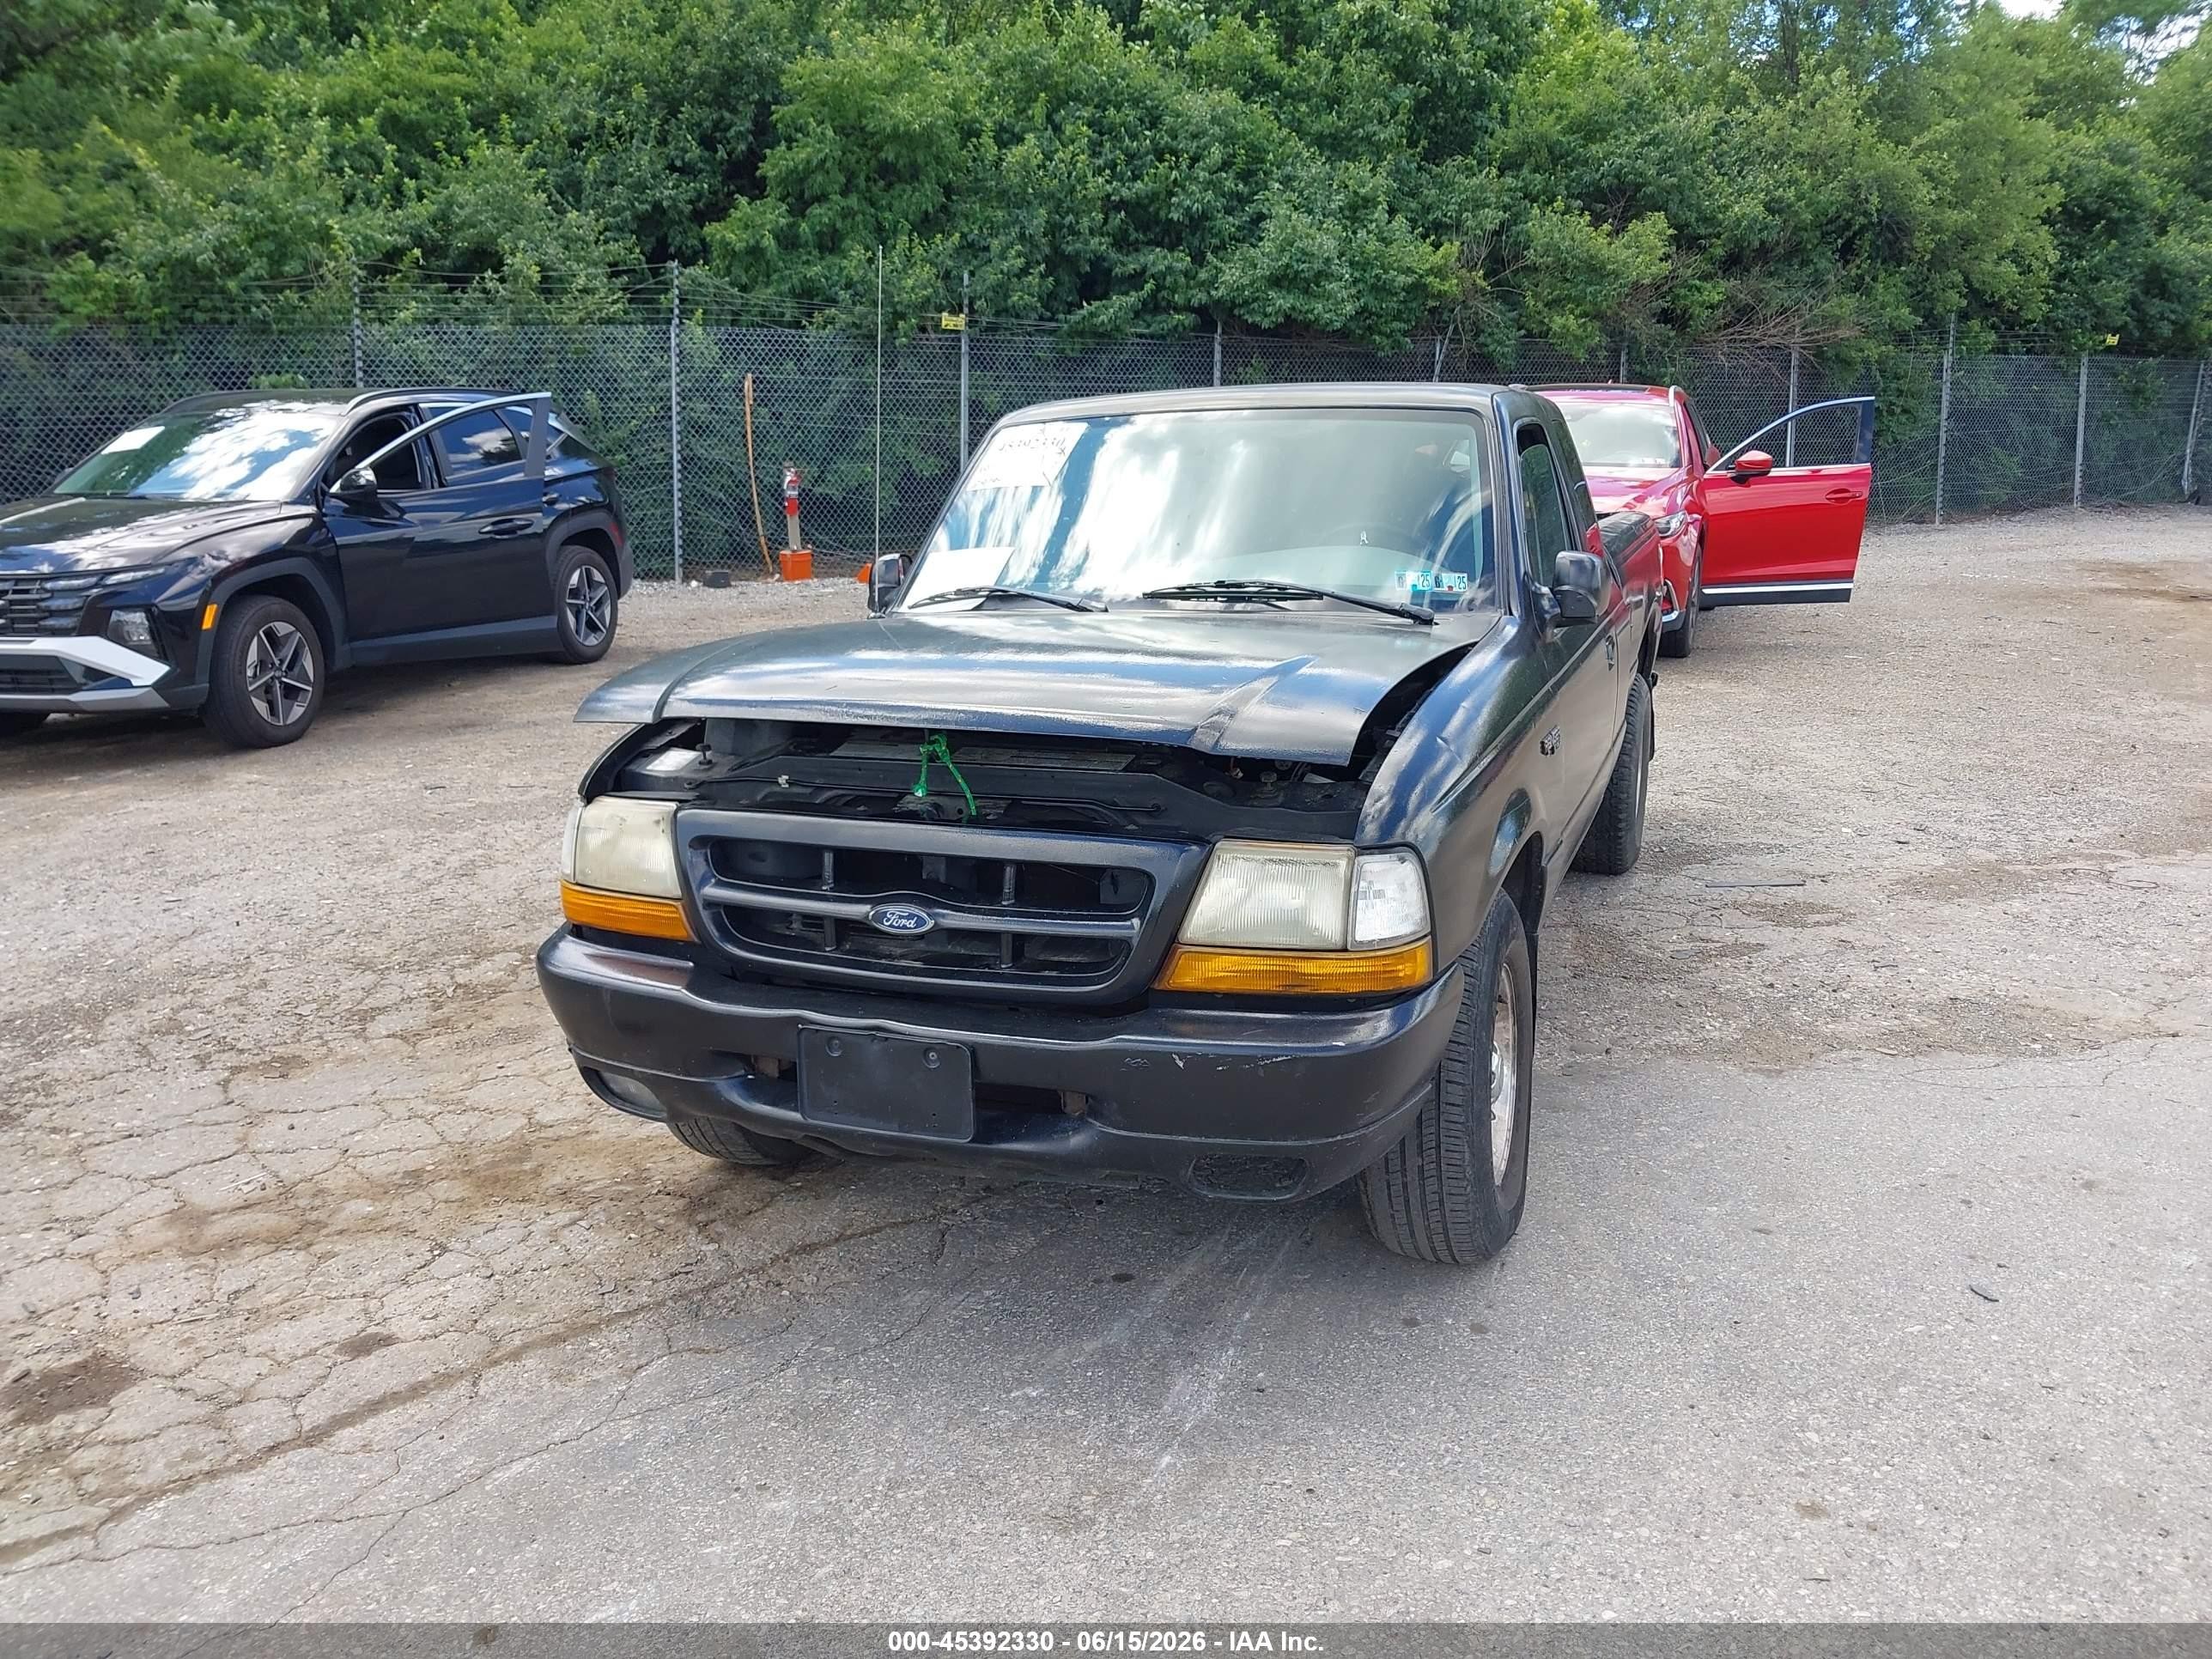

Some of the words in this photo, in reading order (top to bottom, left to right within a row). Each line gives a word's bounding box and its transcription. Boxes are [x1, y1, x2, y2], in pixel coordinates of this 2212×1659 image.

[1421, 574, 1430, 587] 25
[1458, 575, 1467, 590] 25
[883, 910, 917, 928] Ford
